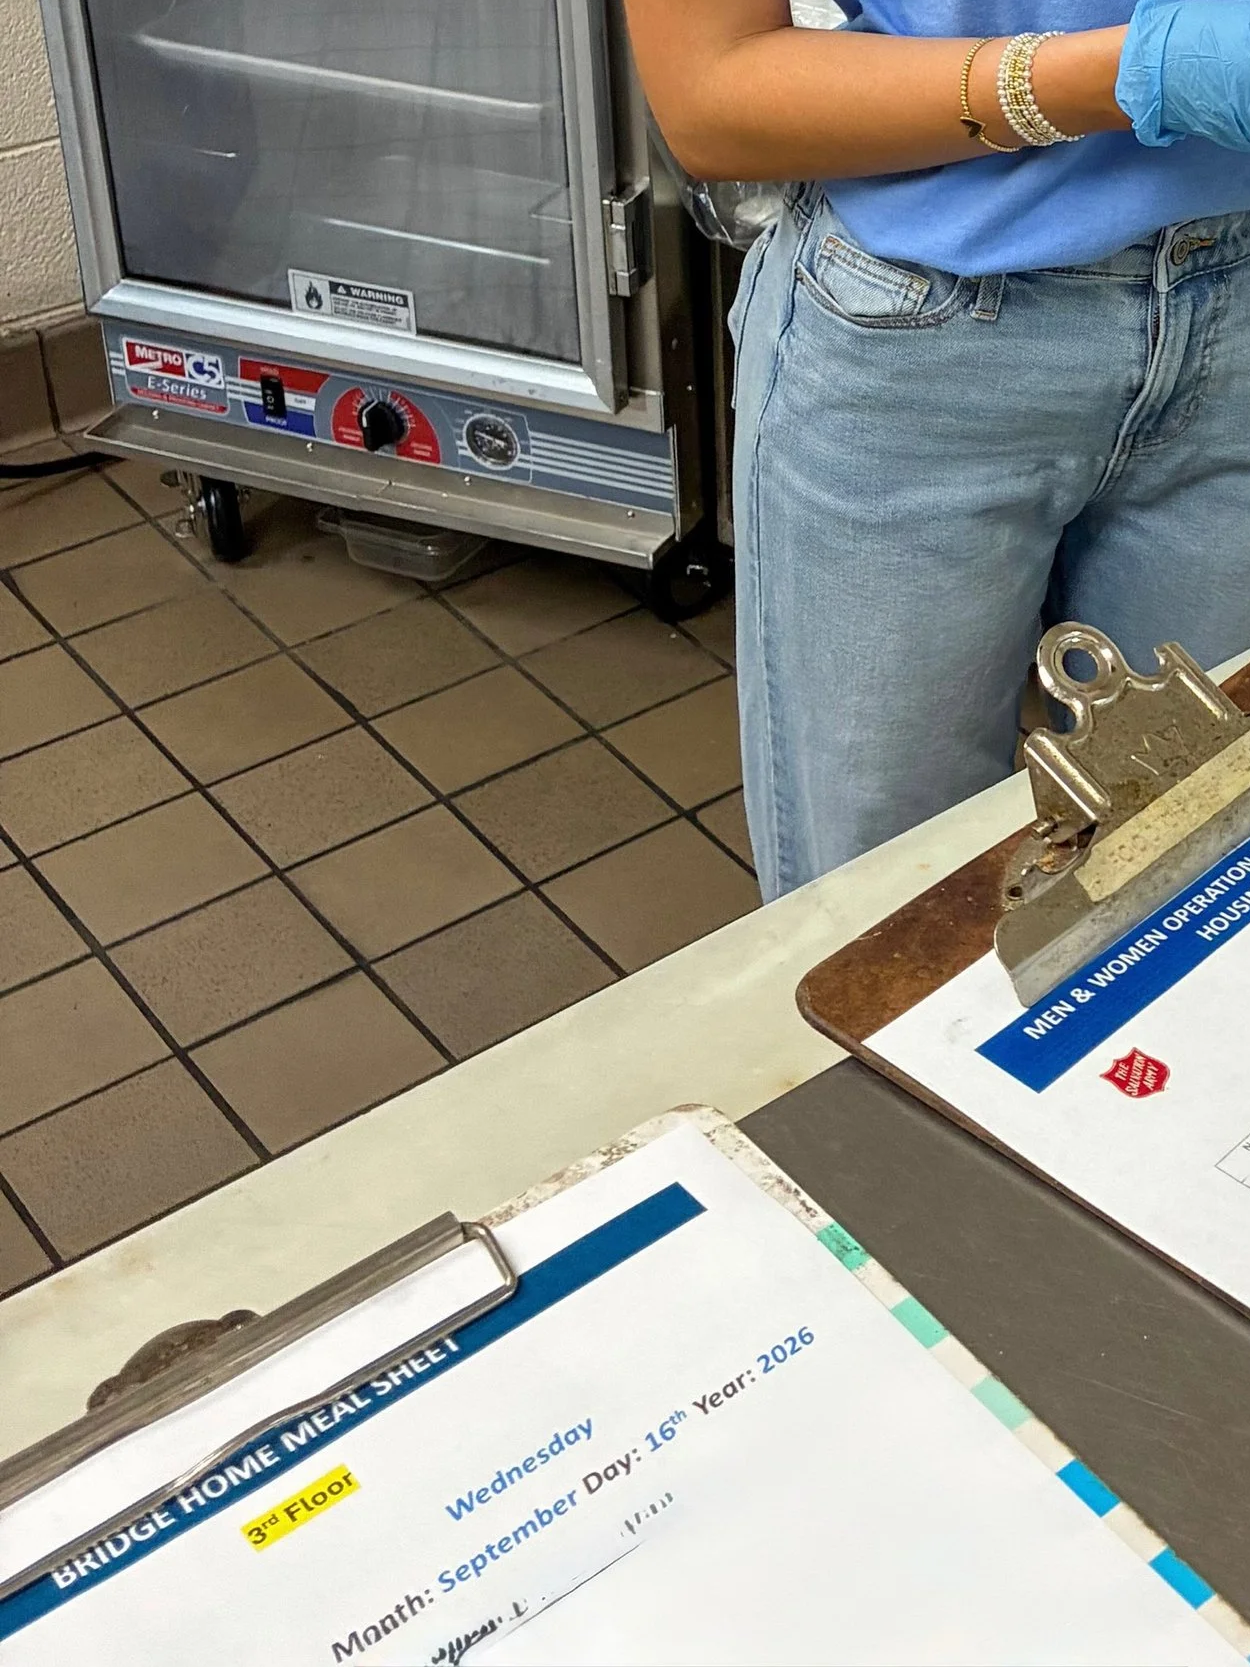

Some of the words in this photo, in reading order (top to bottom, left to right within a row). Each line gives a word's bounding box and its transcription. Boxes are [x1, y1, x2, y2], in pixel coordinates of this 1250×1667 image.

[350, 286, 405, 305] WARNING
[146, 375, 208, 400] E-Series
[186, 351, 221, 384] C5
[1023, 1000, 1076, 1040] MEN
[1070, 987, 1096, 1004] &
[1087, 929, 1168, 988] WOMEN
[51, 1508, 176, 1590] BRIDGE
[175, 1443, 280, 1514] HOME
[279, 1390, 372, 1453] MEAL
[370, 1337, 461, 1397] SHEET
[330, 1588, 435, 1663] Month:
[438, 1489, 577, 1593] September
[582, 1447, 642, 1495] Day:
[645, 1409, 688, 1452] 16th
[692, 1369, 755, 1416] Year:
[756, 1326, 815, 1374] 2026
[445, 1417, 593, 1521] Wednesday
[247, 1513, 280, 1545] 3rd
[283, 1472, 353, 1523] Floor
